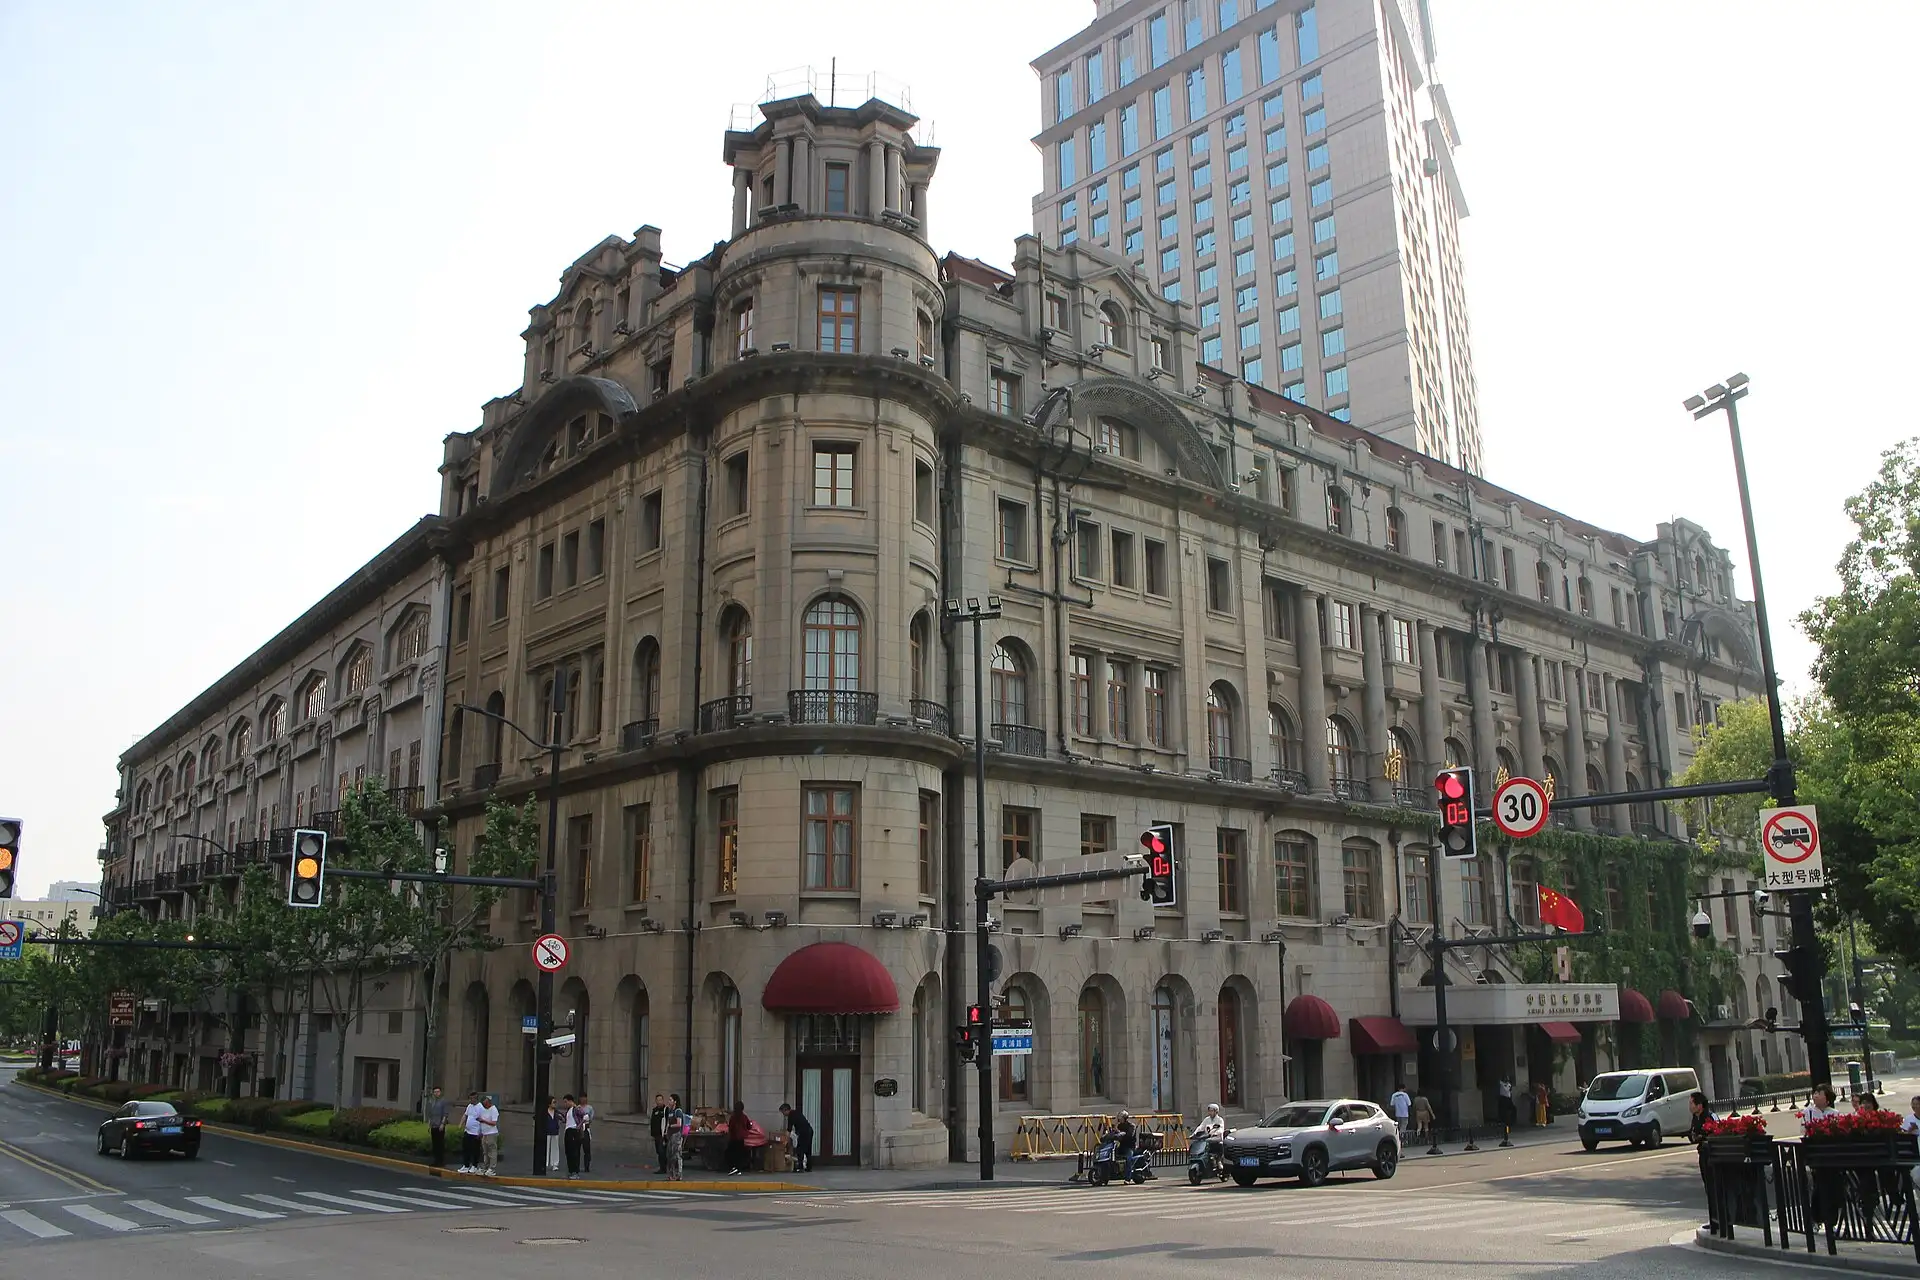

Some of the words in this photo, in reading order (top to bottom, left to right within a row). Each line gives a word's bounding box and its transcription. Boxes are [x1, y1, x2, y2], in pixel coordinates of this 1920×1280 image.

[1503, 792, 1537, 823] 30
[1768, 868, 1822, 886] 大型号牌
